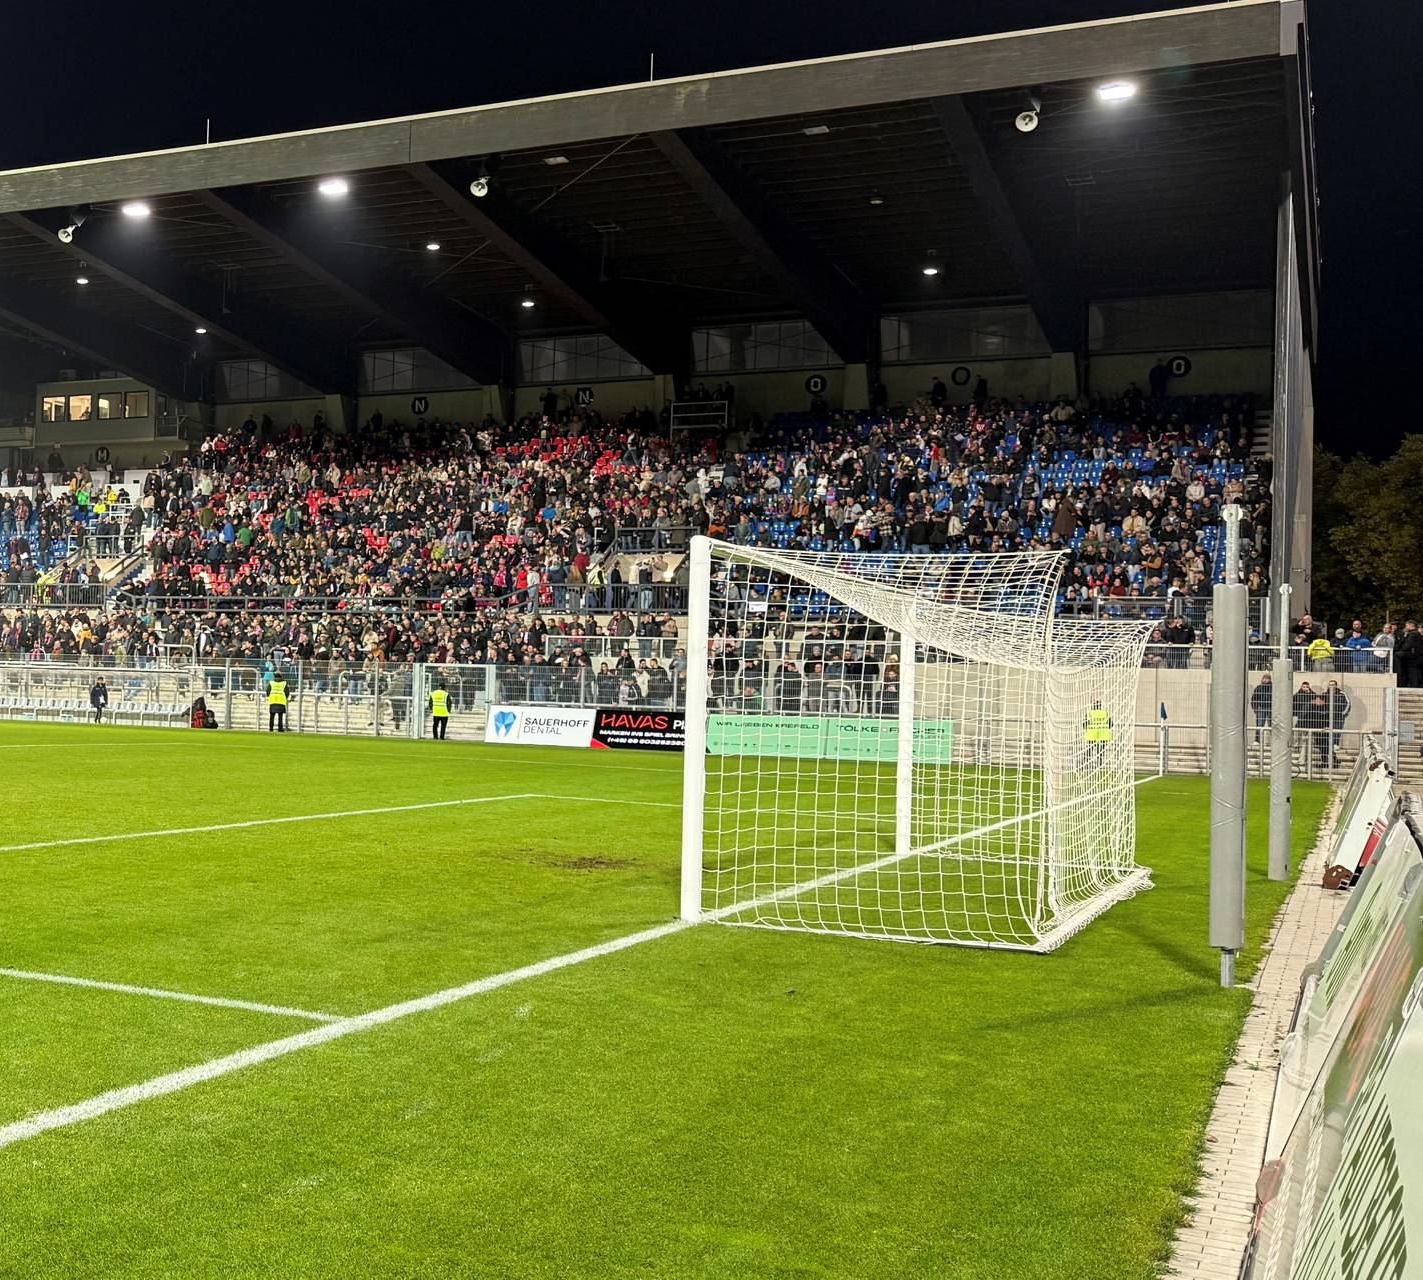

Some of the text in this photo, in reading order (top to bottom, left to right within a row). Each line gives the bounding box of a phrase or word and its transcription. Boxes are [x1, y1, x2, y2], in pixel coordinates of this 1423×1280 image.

[578, 390, 590, 404] N
[415, 399, 425, 413] N
[97, 448, 107, 461] M
[524, 717, 590, 728] SAUERHOFF
[600, 713, 669, 730] HAVAS
[523, 725, 561, 735] DENTAL
[599, 729, 630, 737] MARKEN
